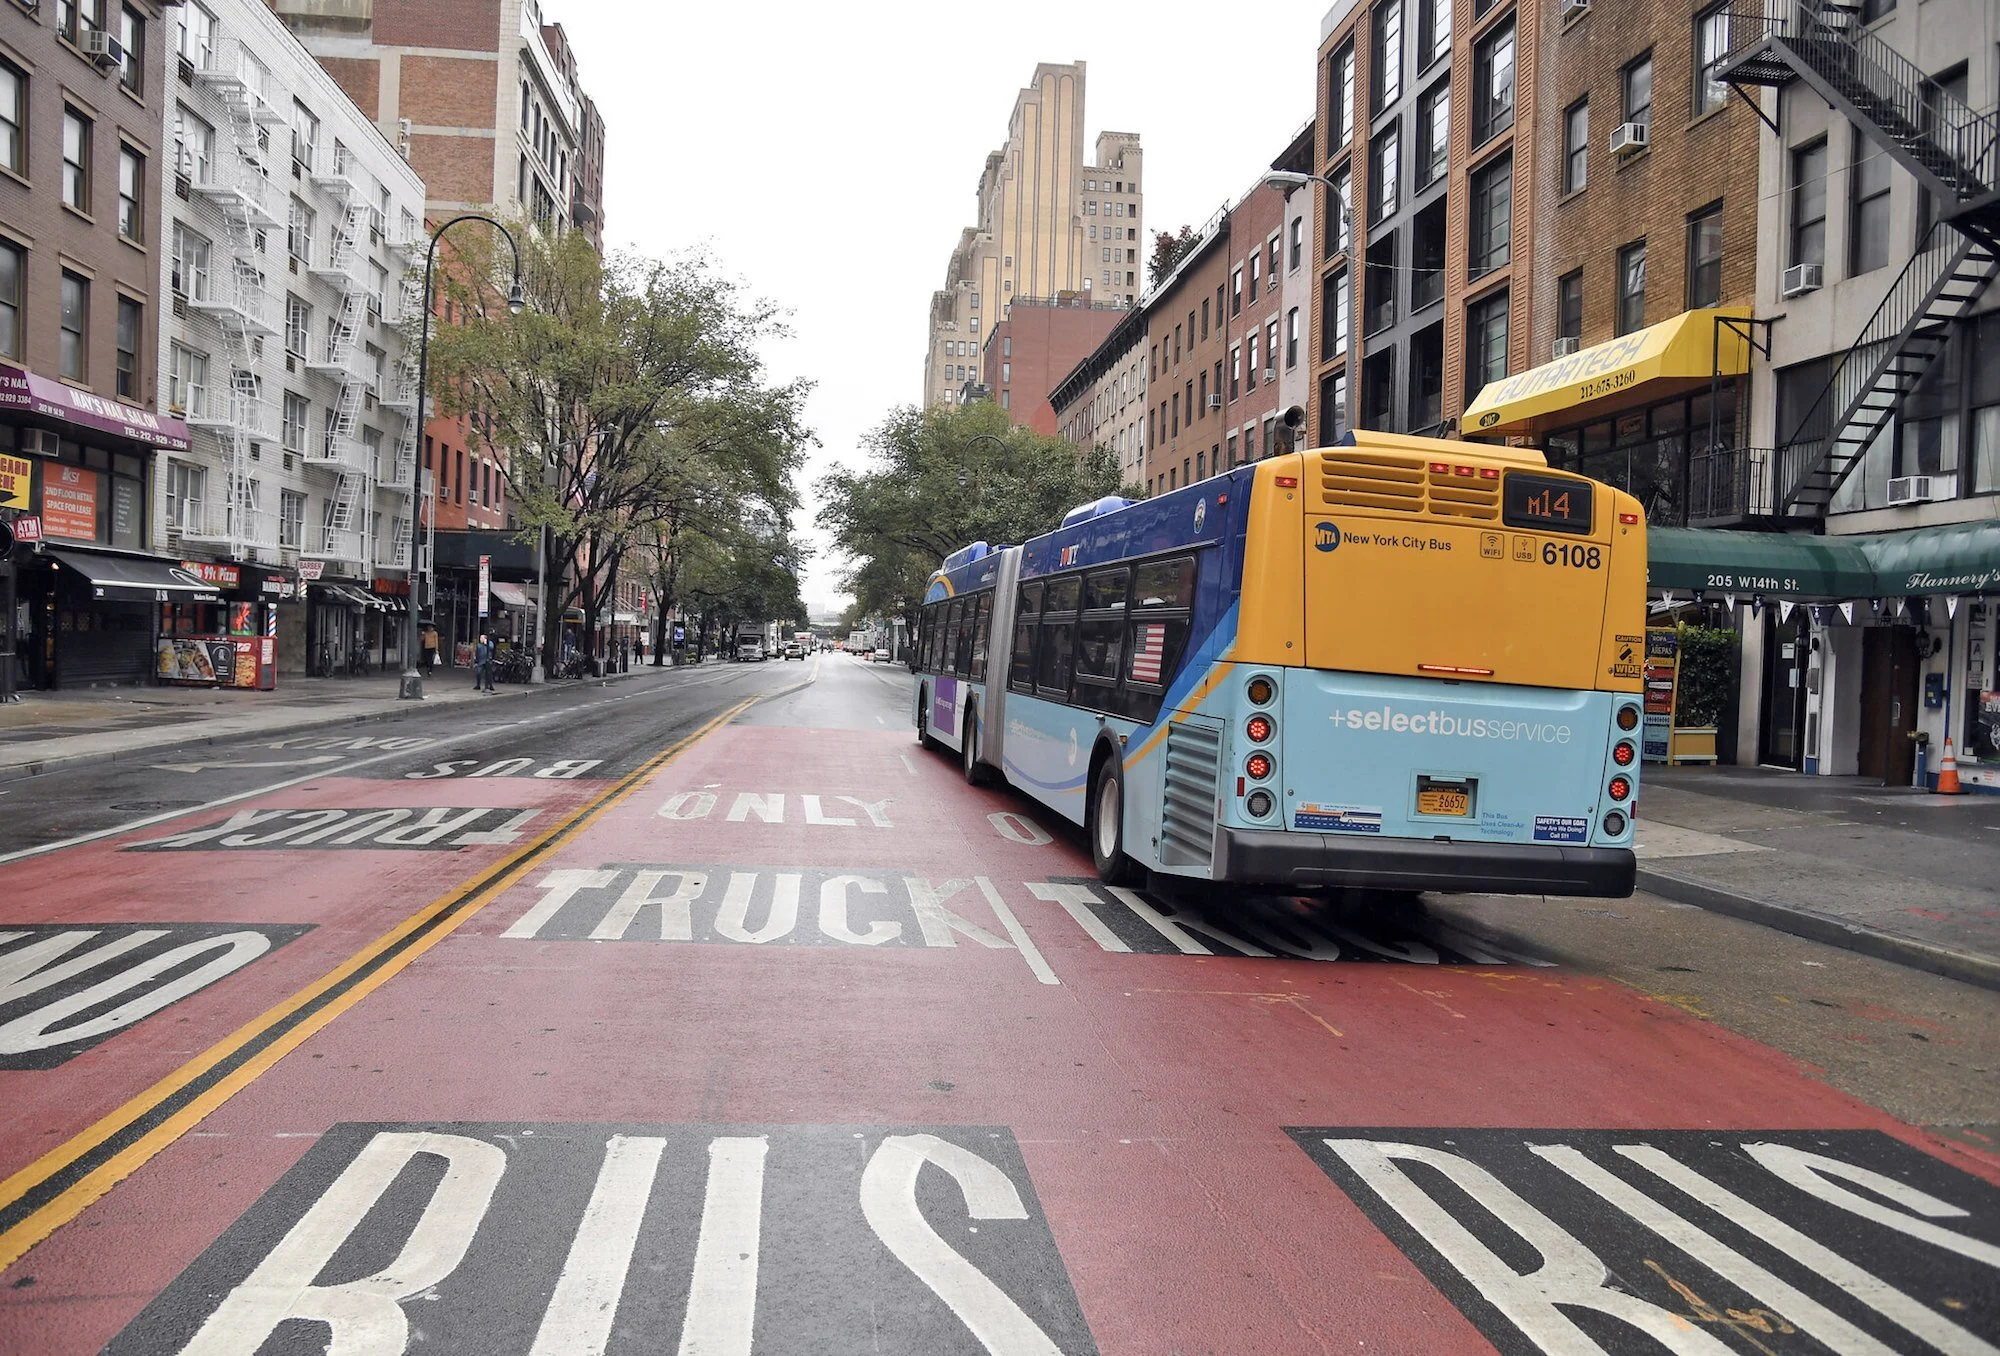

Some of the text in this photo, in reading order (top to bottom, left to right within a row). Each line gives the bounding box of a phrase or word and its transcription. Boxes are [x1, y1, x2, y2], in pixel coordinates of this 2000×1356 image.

[11, 377, 28, 390] NAIL
[1580, 369, 1636, 399] 212-675-3260
[69, 390, 159, 429] MAY'S NAIL SALON
[124, 426, 139, 438] TEL:
[140, 430, 152, 441] 212
[155, 434, 167, 445] 929
[172, 438, 187, 449] 3384
[46, 500, 92, 516] SPACE FOR LEASE
[1527, 488, 1570, 520] M14
[17, 519, 38, 534] ATM
[1343, 532, 1452, 551] New York City Bus
[1516, 551, 1532, 560] USB
[1542, 542, 1601, 569] 6108
[299, 561, 322, 570] BARBER
[218, 567, 237, 582] Pizza
[302, 570, 318, 578] SHOP
[1906, 568, 2000, 590] Flannery's
[1707, 574, 1733, 587] 205
[1784, 579, 1800, 591] St.
[1616, 635, 1642, 643] CAUTION
[1615, 664, 1641, 674] WIDE
[405, 757, 604, 779] BUS
[657, 790, 895, 828] ONLY
[118, 808, 544, 848] TRUCK
[1536, 818, 1560, 826] SAFETY'S
[1573, 819, 1586, 827] GOAL
[1567, 826, 1585, 834] Doing?
[1481, 828, 1514, 837] Technology
[500, 868, 1017, 948] TRUCK
